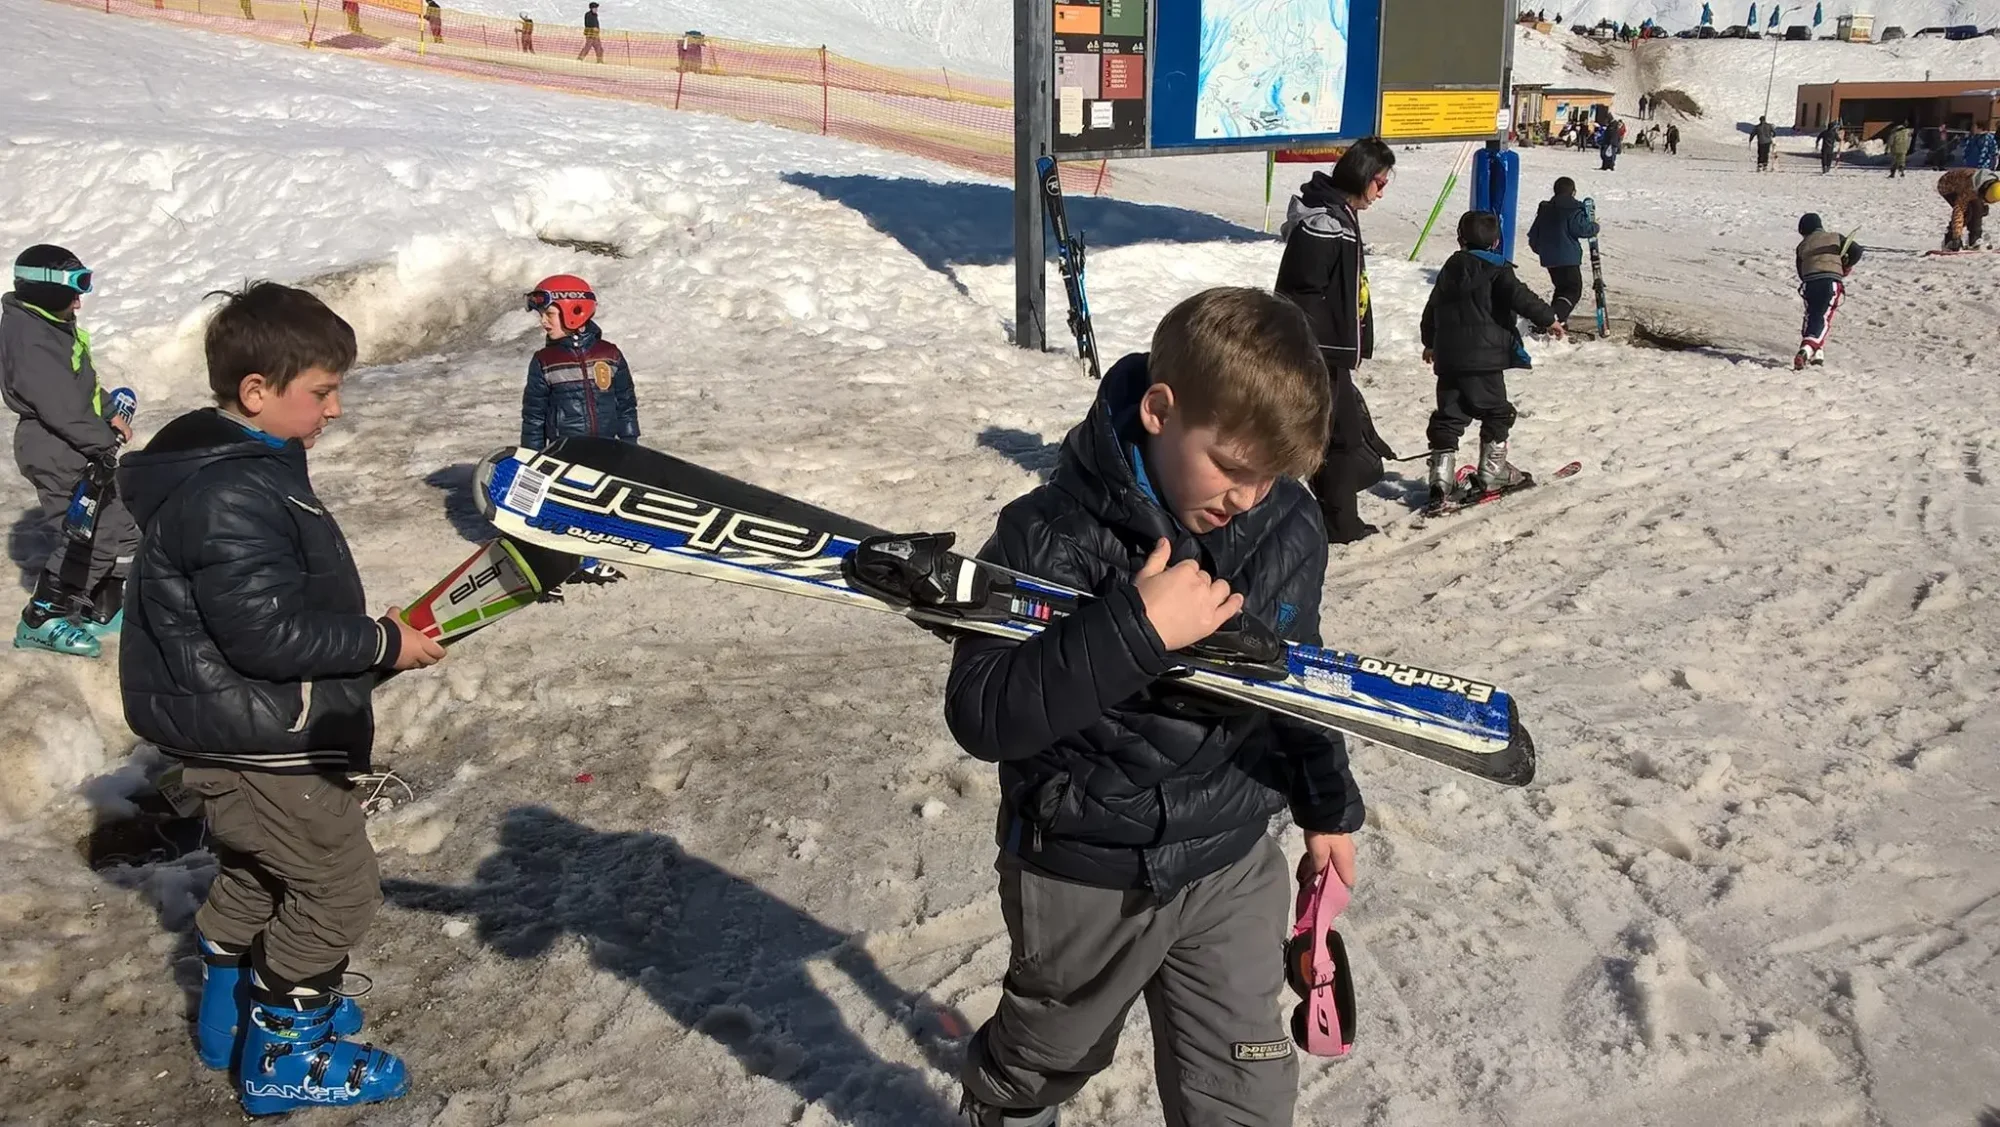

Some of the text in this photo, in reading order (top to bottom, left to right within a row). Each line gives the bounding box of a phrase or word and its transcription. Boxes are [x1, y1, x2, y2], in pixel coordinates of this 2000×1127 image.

[551, 291, 587, 299] uvex
[566, 525, 652, 555] ExarPro
[1359, 657, 1494, 704] ExarPro
[245, 1079, 349, 1103] LANGE
